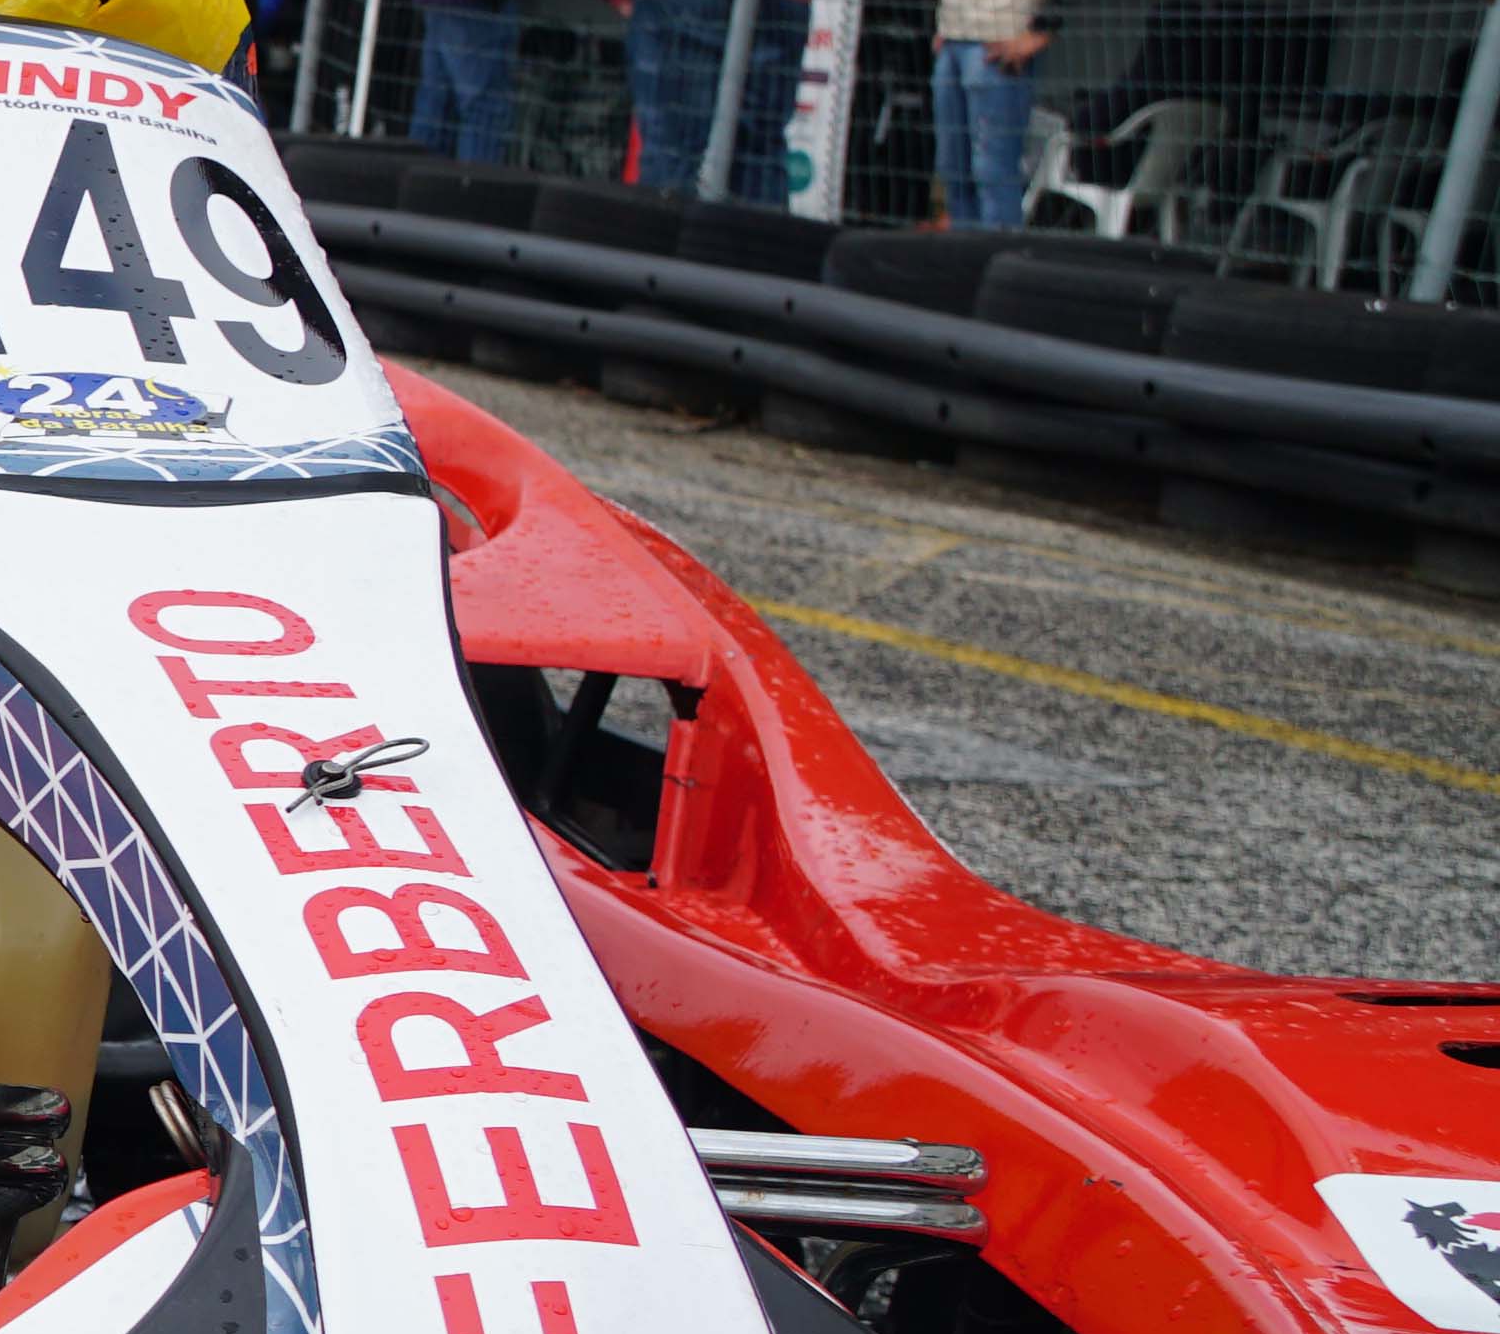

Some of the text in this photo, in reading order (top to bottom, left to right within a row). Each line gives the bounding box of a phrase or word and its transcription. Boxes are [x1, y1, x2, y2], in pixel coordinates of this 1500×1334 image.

[105, 109, 133, 125] da
[137, 114, 218, 147] Batalha
[7, 374, 158, 416] 24
[19, 416, 211, 435] da Batalha
[52, 405, 143, 421] horas
